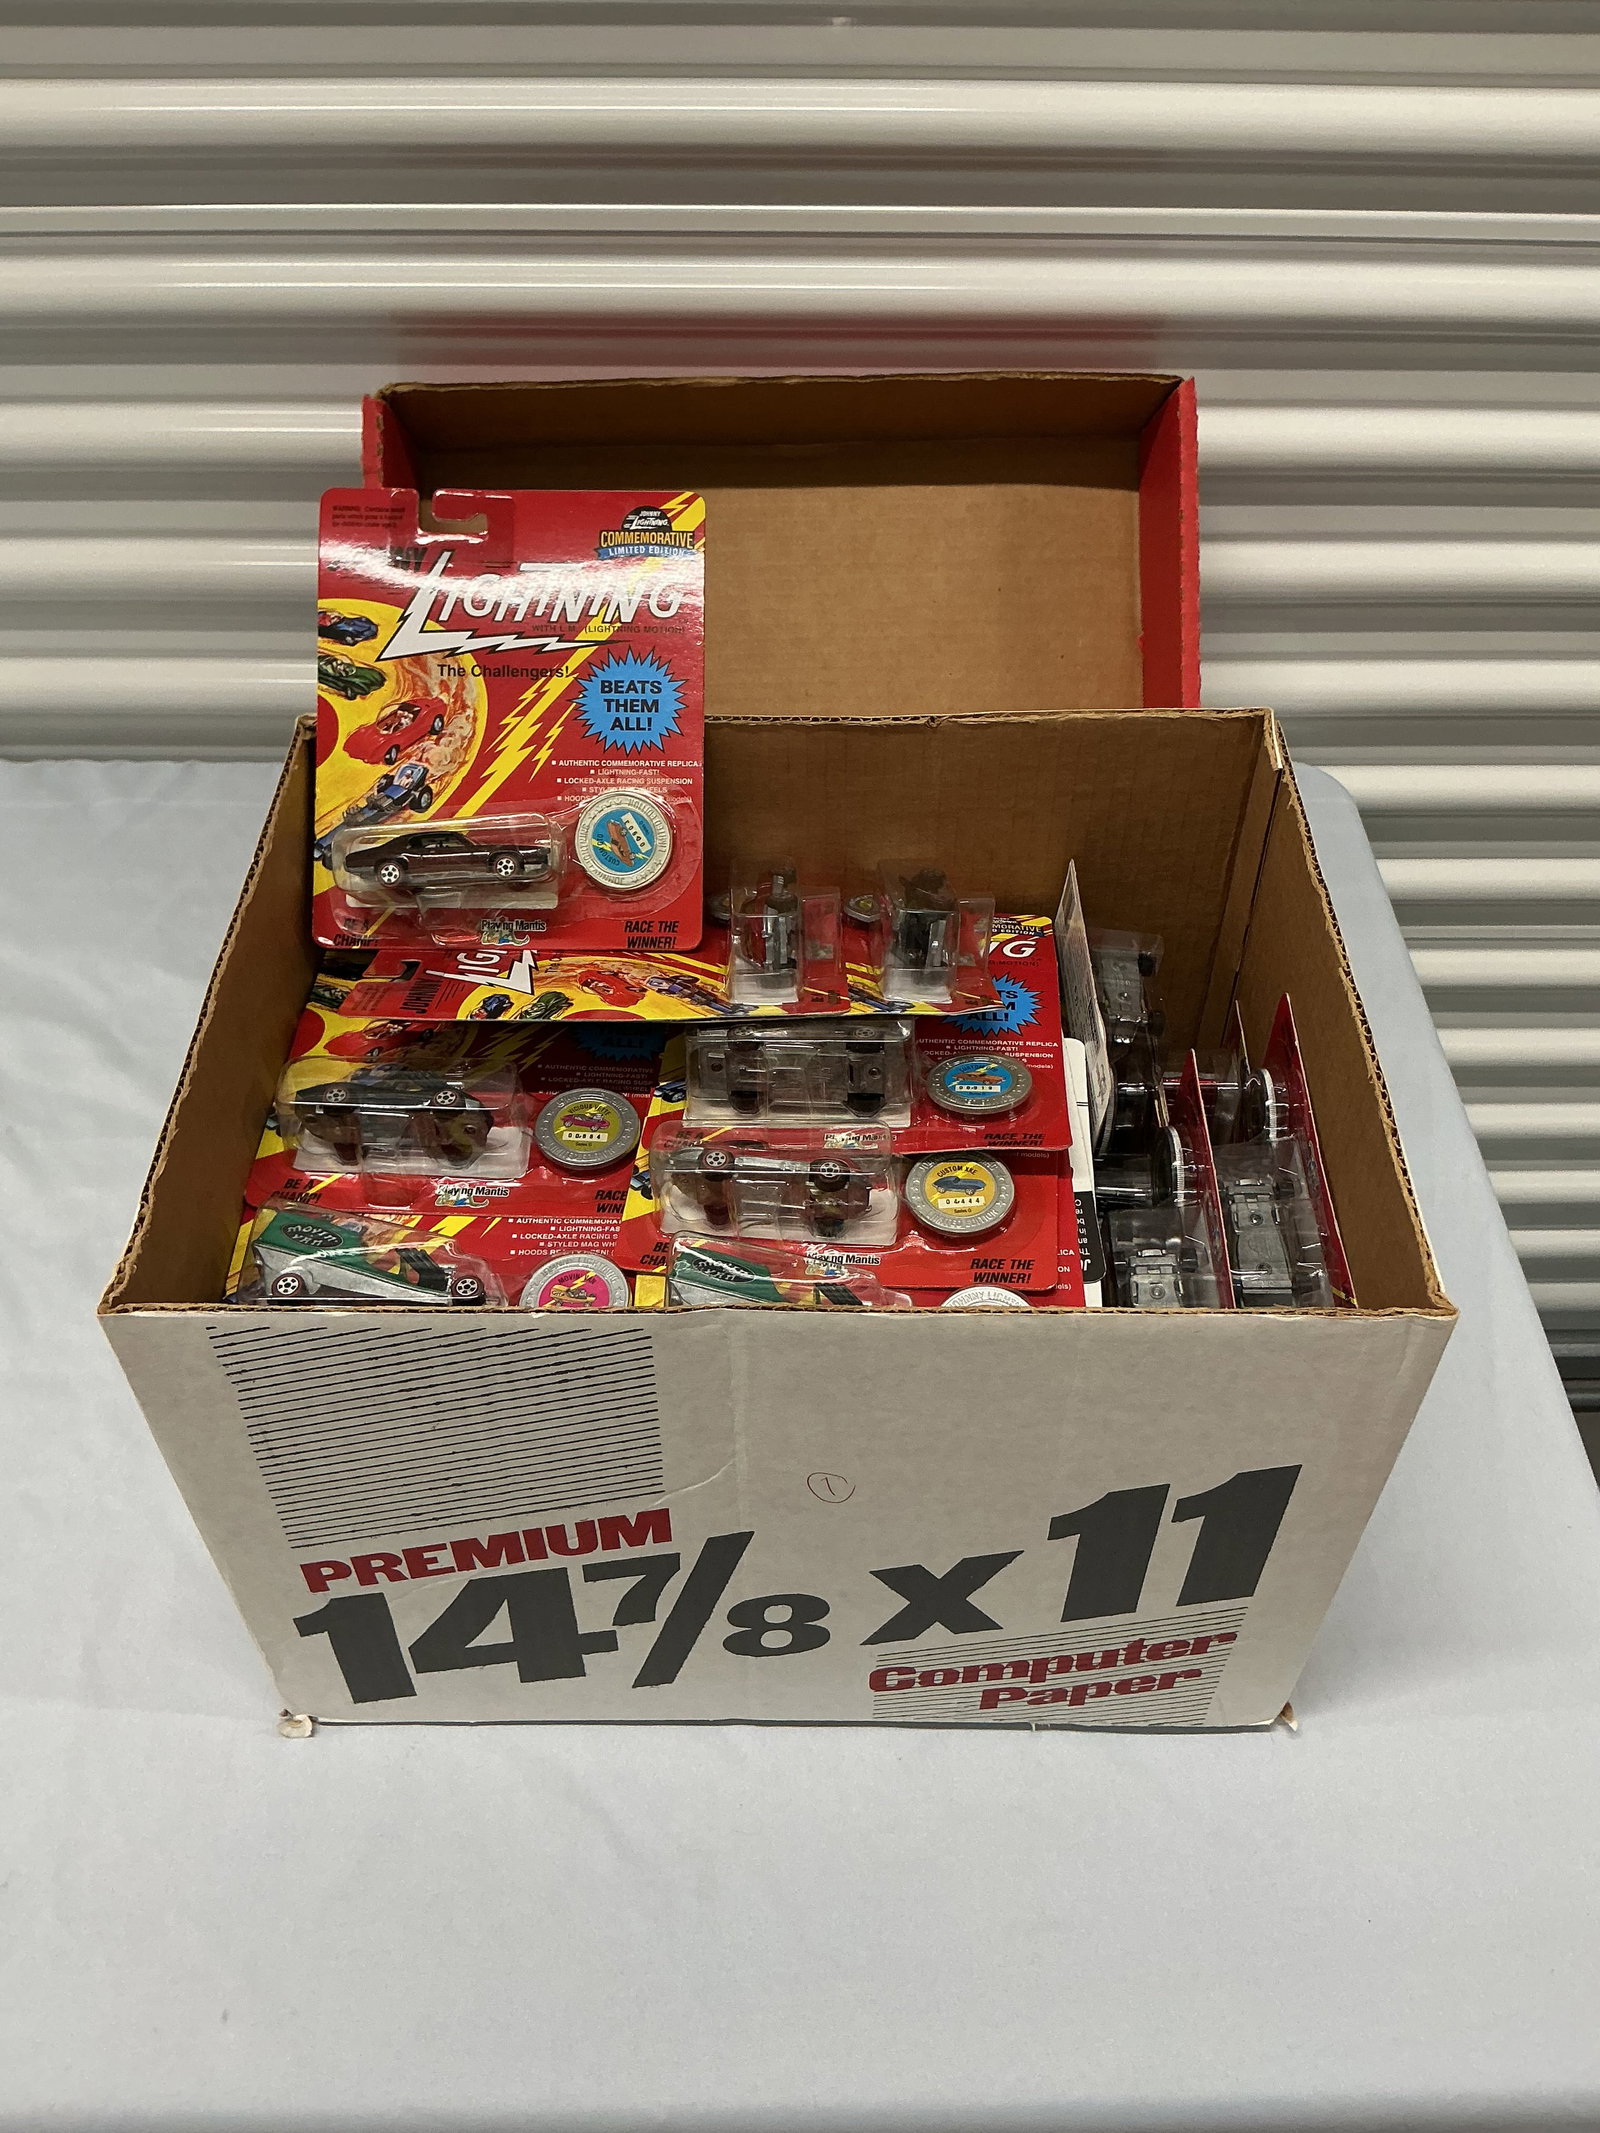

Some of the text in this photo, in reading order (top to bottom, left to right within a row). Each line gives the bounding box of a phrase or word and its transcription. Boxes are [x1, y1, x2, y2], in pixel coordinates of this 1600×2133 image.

[600, 530, 694, 549] COMMEMORATIVE
[608, 546, 646, 557] LIMITED
[437, 664, 570, 681] The Challengers!
[600, 679, 663, 695] BEATS
[603, 698, 660, 713] THEM
[610, 717, 653, 731] ALL!
[601, 760, 666, 768] COMMEMORATIVE
[564, 777, 615, 785] LOCKED-AXLE
[646, 778, 693, 786] SUSPENSION
[515, 920, 546, 932] Mantis
[624, 921, 680, 933] RACE THE
[627, 936, 677, 949] WINNER!
[936, 1165, 963, 1178] CUSTOM
[284, 1178, 314, 1189] BE A
[475, 1186, 509, 1196] Mantis
[653, 1242, 669, 1253] BE
[640, 1254, 667, 1266] CHA
[845, 1254, 880, 1265] Mantis
[970, 1258, 1036, 1271] RACE THE
[973, 1272, 1032, 1284] WINNER!
[1047, 1464, 1303, 1623] 11
[300, 1508, 673, 1593] PREMIUM
[868, 1632, 1238, 1692] Computer
[979, 1668, 1204, 1710] Paper
